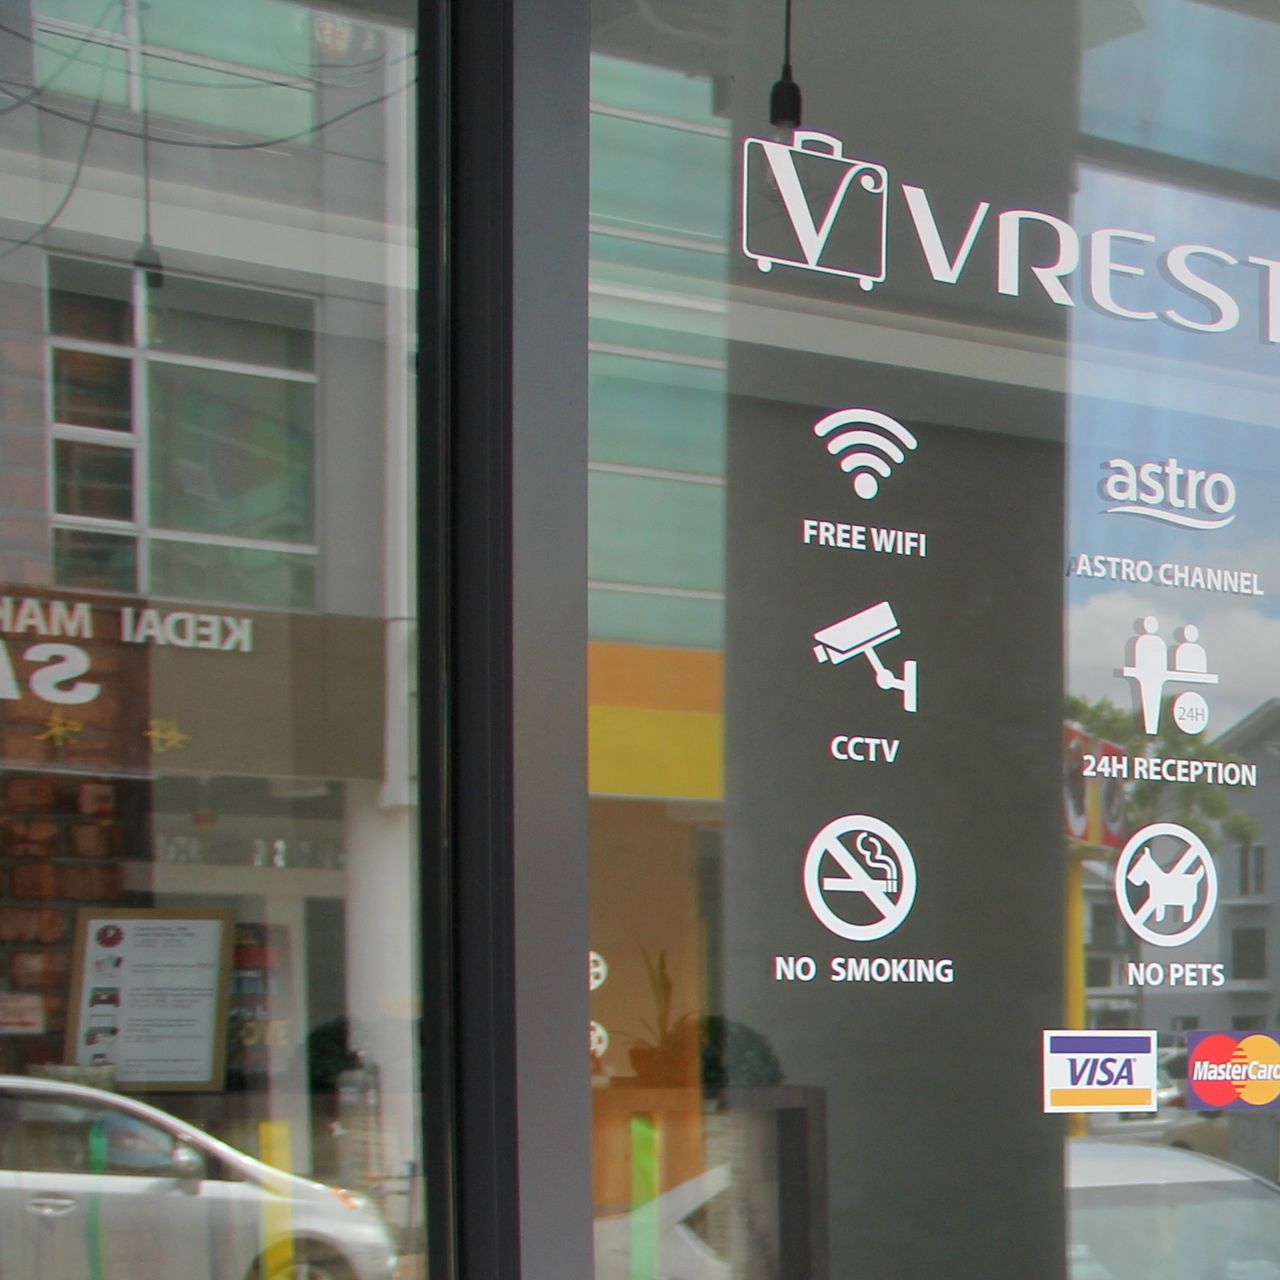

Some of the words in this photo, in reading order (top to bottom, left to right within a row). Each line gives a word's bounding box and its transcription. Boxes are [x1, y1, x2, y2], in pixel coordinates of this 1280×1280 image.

[1106, 457, 1236, 514] astro
[803, 520, 866, 550] FREE
[870, 527, 927, 558] WIFI
[1077, 554, 1153, 586] ASTRO
[1158, 563, 1265, 596] CHANNEL
[1177, 704, 1206, 722] 24H
[831, 735, 900, 763] CCTV
[1082, 754, 1129, 779] 24H
[1133, 756, 1257, 787] RECEPTION
[775, 956, 815, 982] NO
[831, 957, 954, 984] SMOKING
[1128, 962, 1163, 986] NO
[1171, 963, 1225, 987] PETS
[1068, 1057, 1135, 1086] VISA
